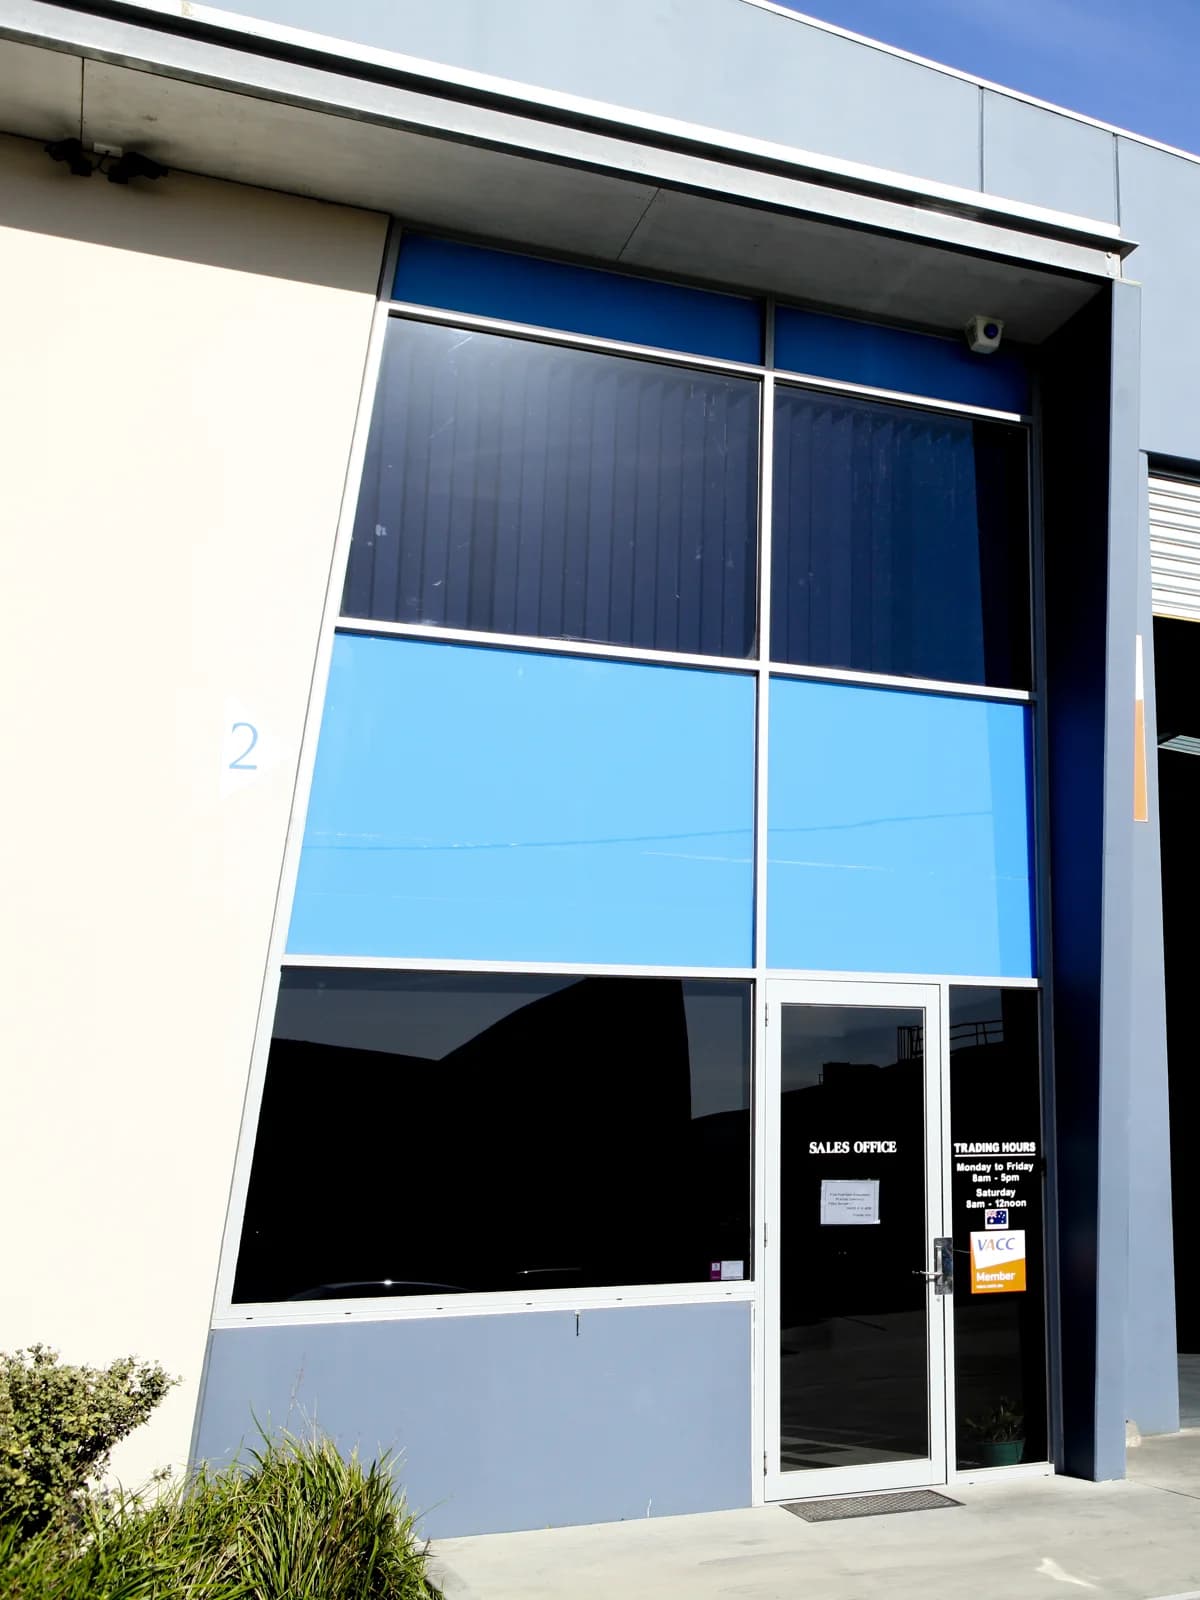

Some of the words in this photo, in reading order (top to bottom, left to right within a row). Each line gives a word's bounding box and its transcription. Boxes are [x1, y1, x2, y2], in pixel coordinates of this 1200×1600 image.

[229, 722, 258, 770] 2
[809, 1141, 850, 1154] SALES
[853, 1141, 897, 1153] OFFICE
[954, 1142, 1000, 1153] TRADING
[1002, 1142, 1036, 1152] HOURS
[956, 1162, 991, 1173] Monday
[994, 1163, 1004, 1171] to
[1006, 1162, 1034, 1172] Friday
[972, 1174, 991, 1183] 8am
[1000, 1173, 1020, 1183] 5pm
[976, 1188, 1016, 1199] Saturday
[966, 1200, 985, 1209] 8am
[995, 1199, 1027, 1208] 12noon
[977, 1237, 1016, 1251] VACC
[976, 1271, 1016, 1282] Member
